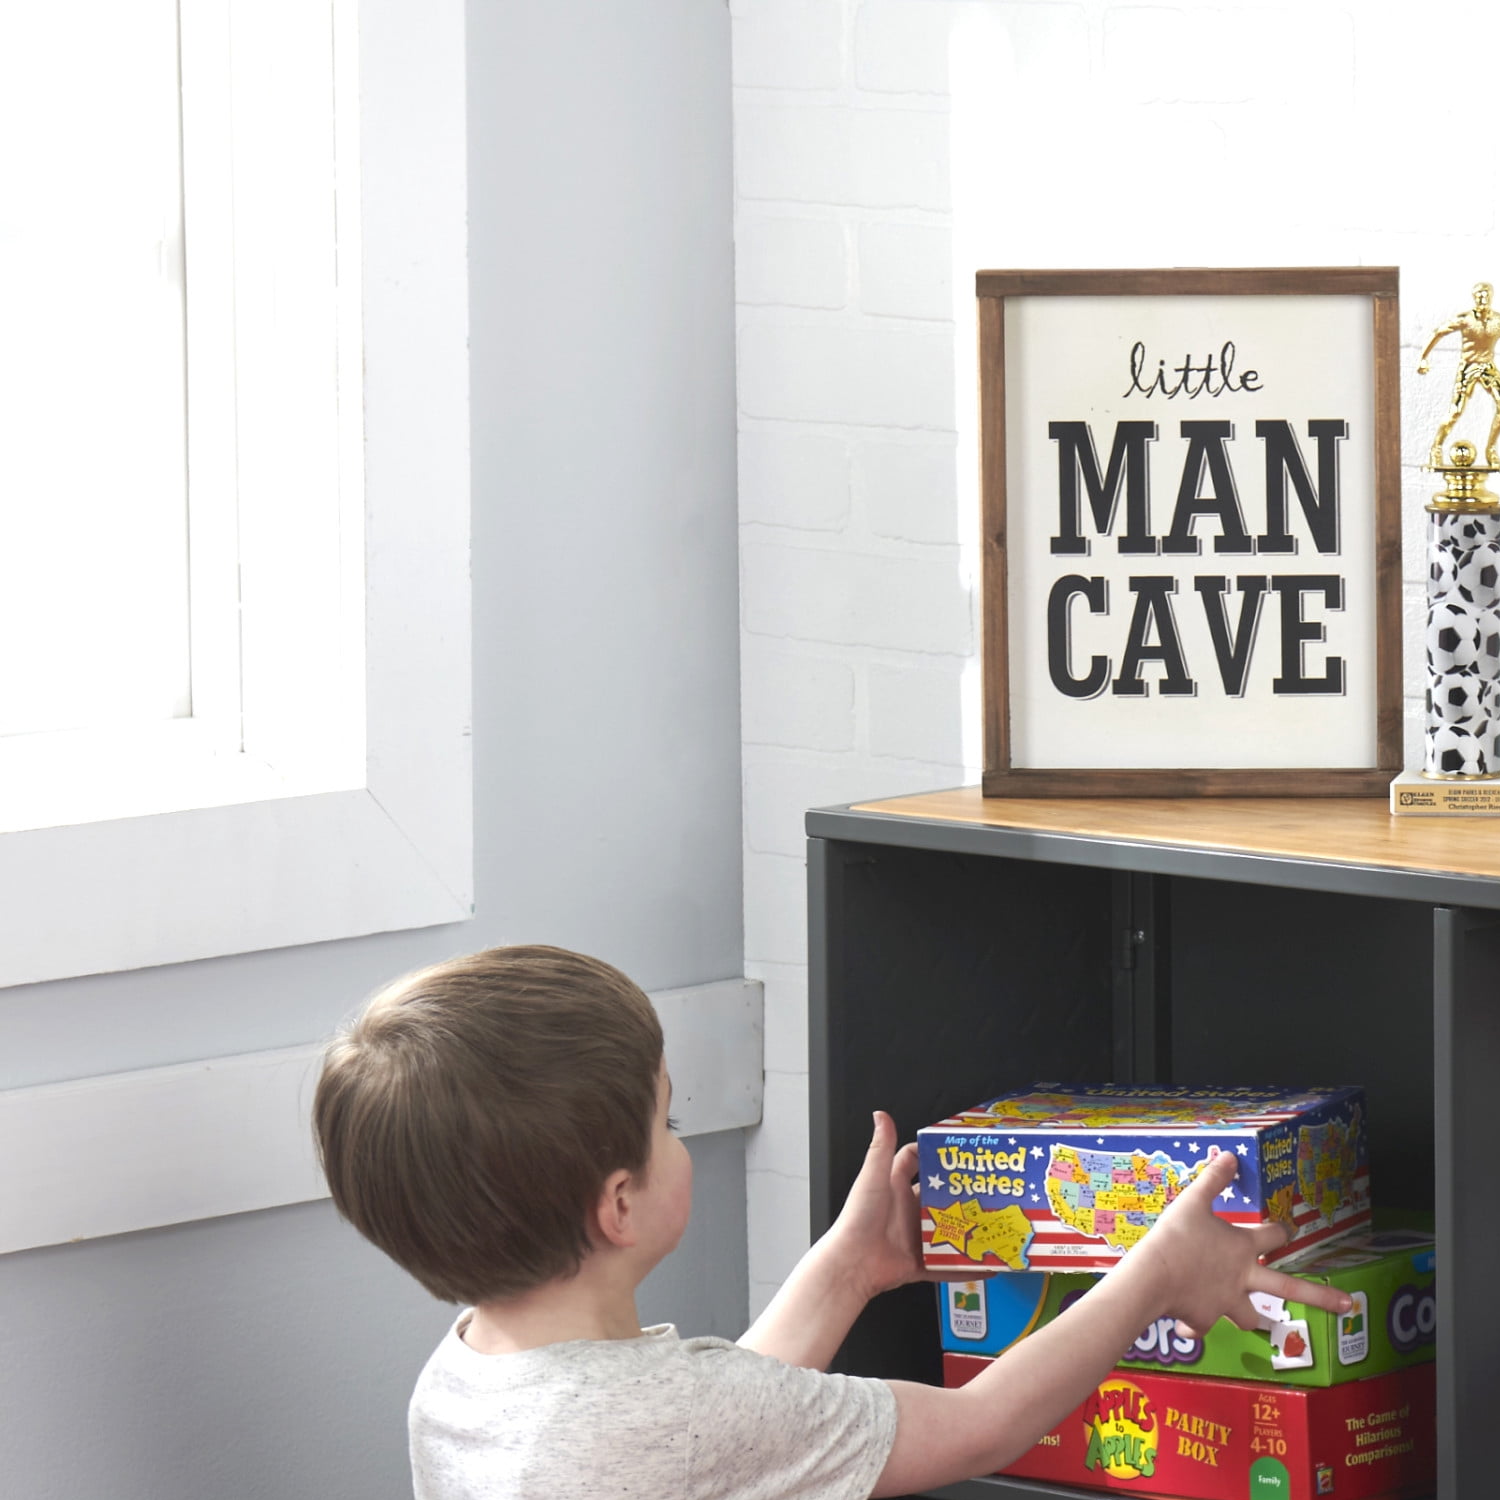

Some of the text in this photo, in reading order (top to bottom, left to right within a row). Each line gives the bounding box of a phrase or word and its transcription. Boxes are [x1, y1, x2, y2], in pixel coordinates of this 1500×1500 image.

[1123, 341, 1264, 399] little
[1048, 418, 1350, 556] MAN
[1046, 574, 1348, 701] CAVE
[945, 1135, 999, 1147] Map of the
[1262, 1132, 1293, 1162] United
[936, 1146, 1027, 1172] United
[1266, 1159, 1293, 1183] States
[948, 1172, 1025, 1196] States
[1083, 1387, 1157, 1432] APPLES
[1252, 1404, 1280, 1421] 12+
[1345, 1405, 1410, 1431] The Game of
[1115, 1422, 1124, 1433] to
[1164, 1407, 1232, 1447] PARTY
[1355, 1426, 1401, 1447] Hilarious
[1085, 1423, 1157, 1477] APPLES
[1176, 1435, 1219, 1467] BOX
[1250, 1437, 1287, 1456] 4-10
[1345, 1438, 1415, 1467] Comparisons!
[1258, 1475, 1281, 1487] Family
